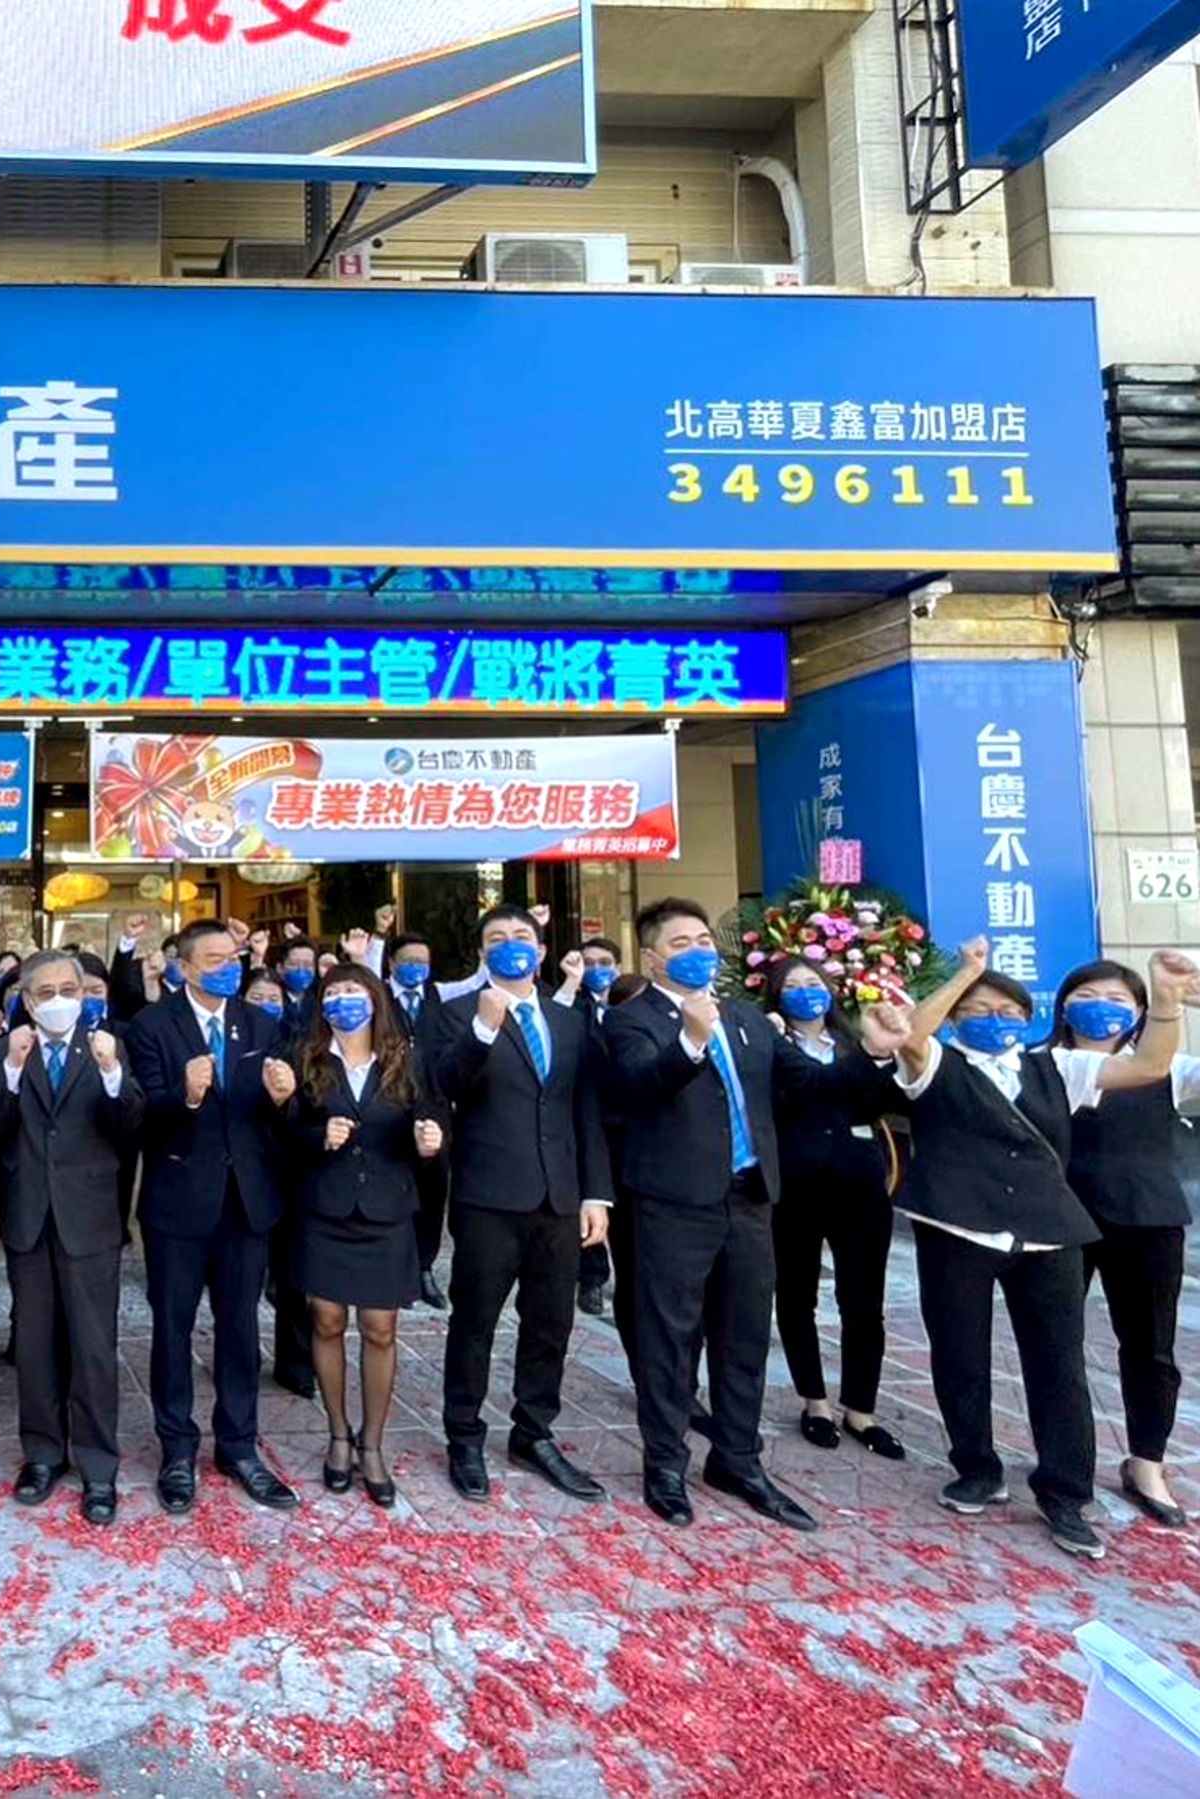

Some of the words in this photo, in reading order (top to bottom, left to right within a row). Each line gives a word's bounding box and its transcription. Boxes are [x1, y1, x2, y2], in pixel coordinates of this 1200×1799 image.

[665, 399, 1026, 443] 北高華夏鑫富加盟店
[667, 462, 1033, 505] 3496111
[417, 749, 536, 771] 台慶不動產
[271, 782, 635, 826] 專業熱情為您服務
[819, 742, 844, 841] 成家有
[977, 723, 1039, 981] 台慶不動產
[1138, 872, 1193, 898] 626
